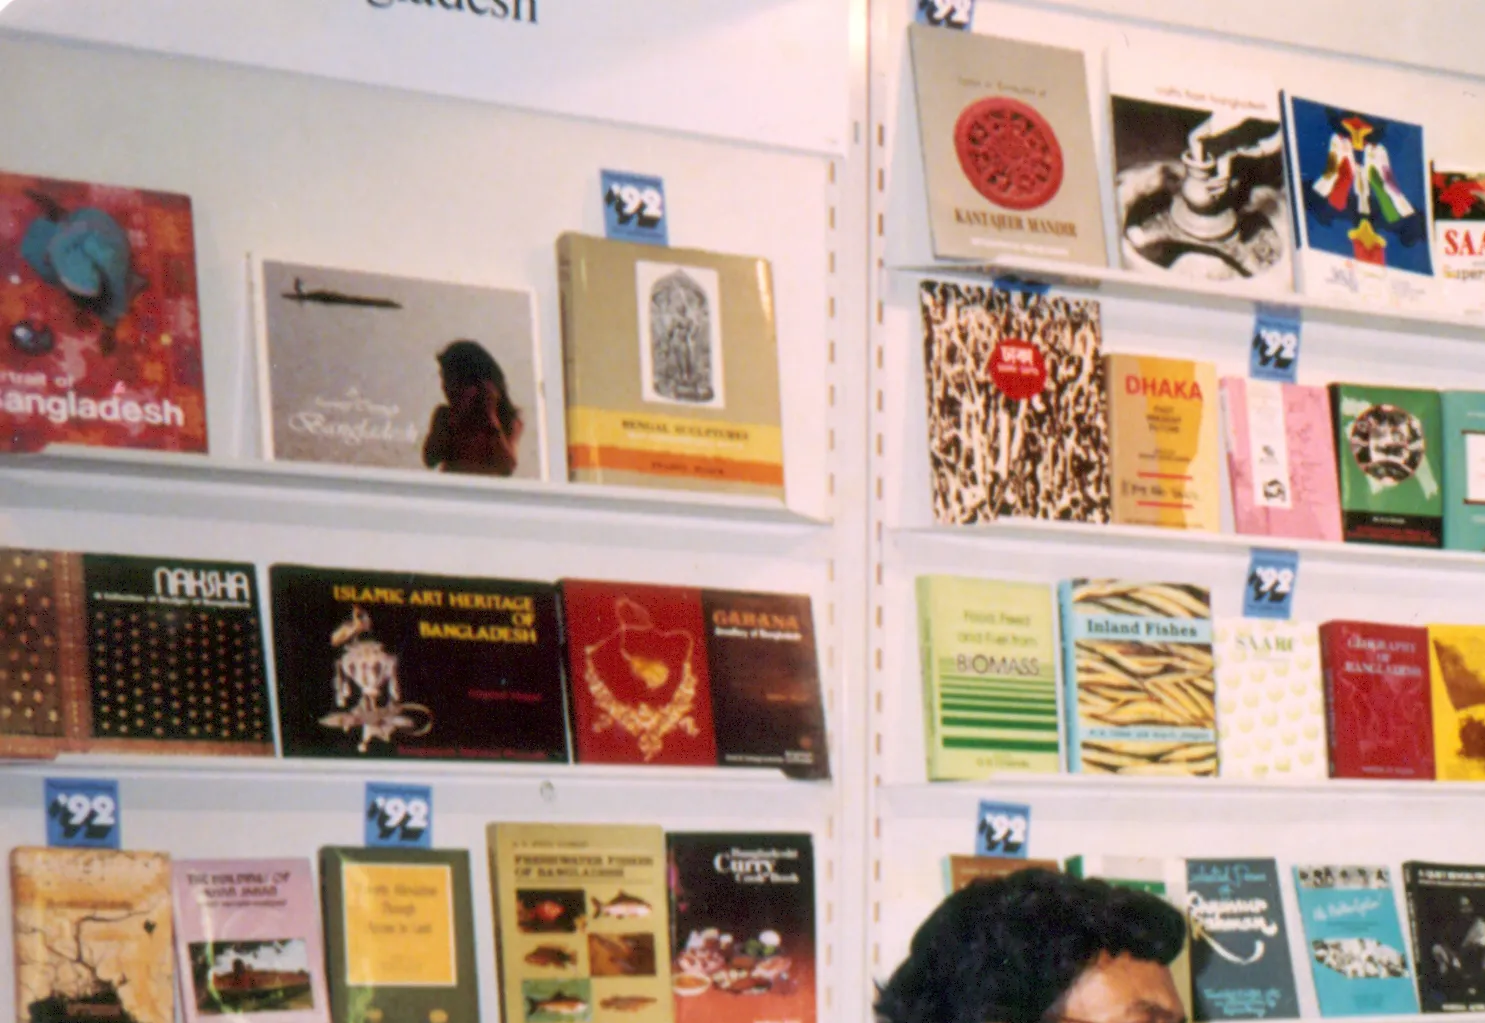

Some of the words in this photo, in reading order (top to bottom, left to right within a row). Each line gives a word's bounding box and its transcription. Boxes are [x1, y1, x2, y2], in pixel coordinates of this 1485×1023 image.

[606, 181, 664, 224] '92
[1028, 217, 1078, 239] MANDIR
[1257, 328, 1298, 363] '92
[1124, 375, 1204, 401] DHAKA
[0, 389, 185, 427] angladesh
[154, 566, 250, 603] NAKSHA
[1253, 565, 1296, 598] '92
[333, 585, 404, 605] ISLAMIC
[410, 589, 445, 606] ART
[448, 592, 534, 611] HERITAGE
[419, 621, 538, 644] BANGLADESH
[512, 613, 536, 628] OF
[1087, 619, 1140, 636] Inland
[1145, 620, 1198, 638] Fishes
[957, 653, 1040, 677] BIOMASS
[1344, 660, 1422, 677] BANGLADESH
[56, 791, 116, 830] '92
[374, 794, 430, 833] '92
[982, 811, 1028, 847] '92
[713, 853, 773, 876] Curry
